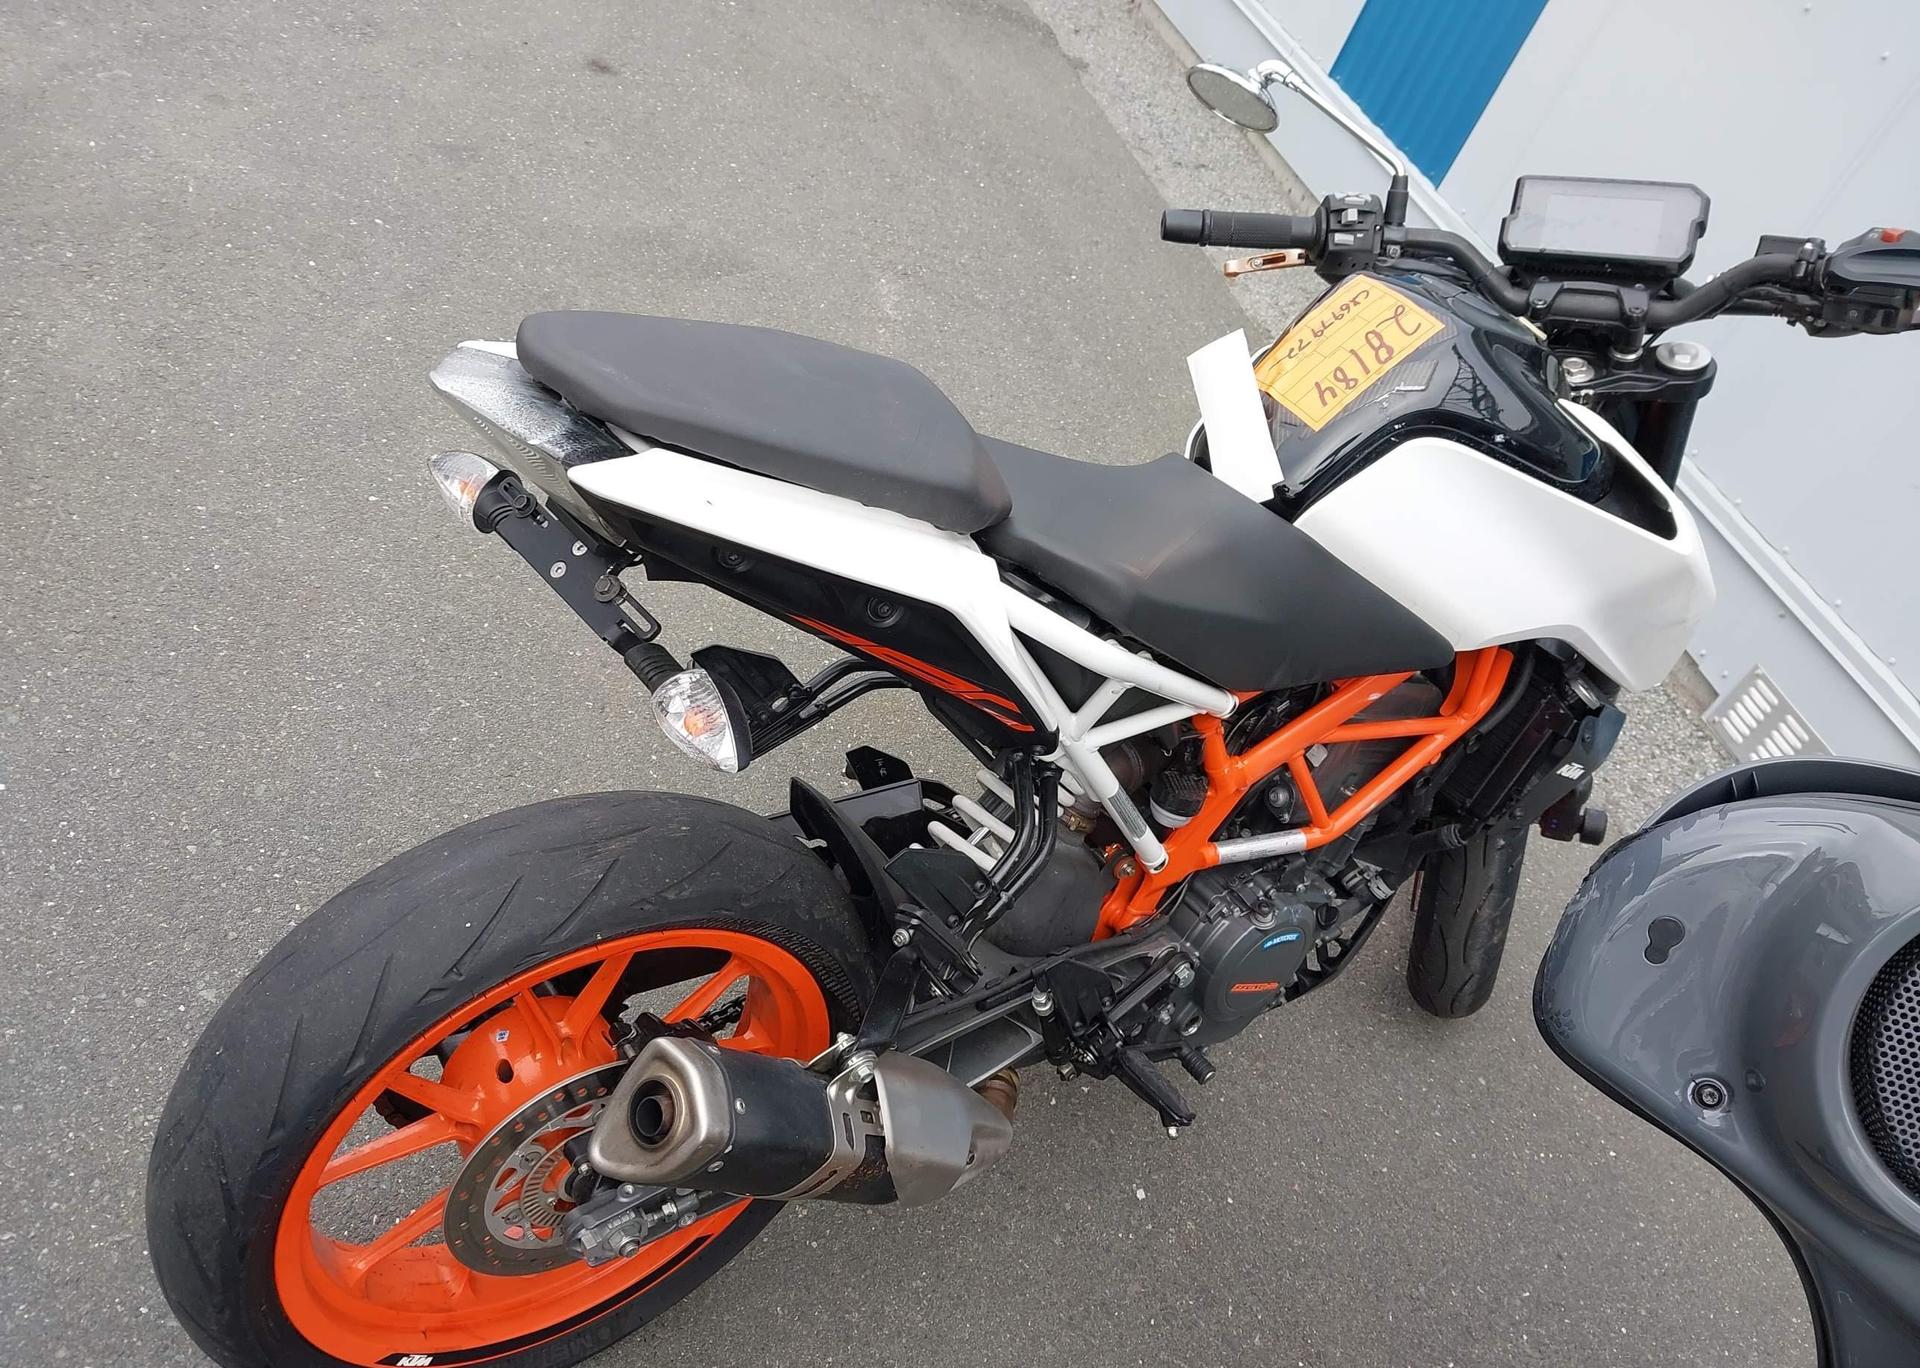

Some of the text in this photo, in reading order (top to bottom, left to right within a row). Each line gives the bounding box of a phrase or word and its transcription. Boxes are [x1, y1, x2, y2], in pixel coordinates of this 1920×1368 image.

[1315, 304, 1422, 407] 28184
[1557, 763, 1585, 780] KTM
[396, 1354, 434, 1367] KTM
